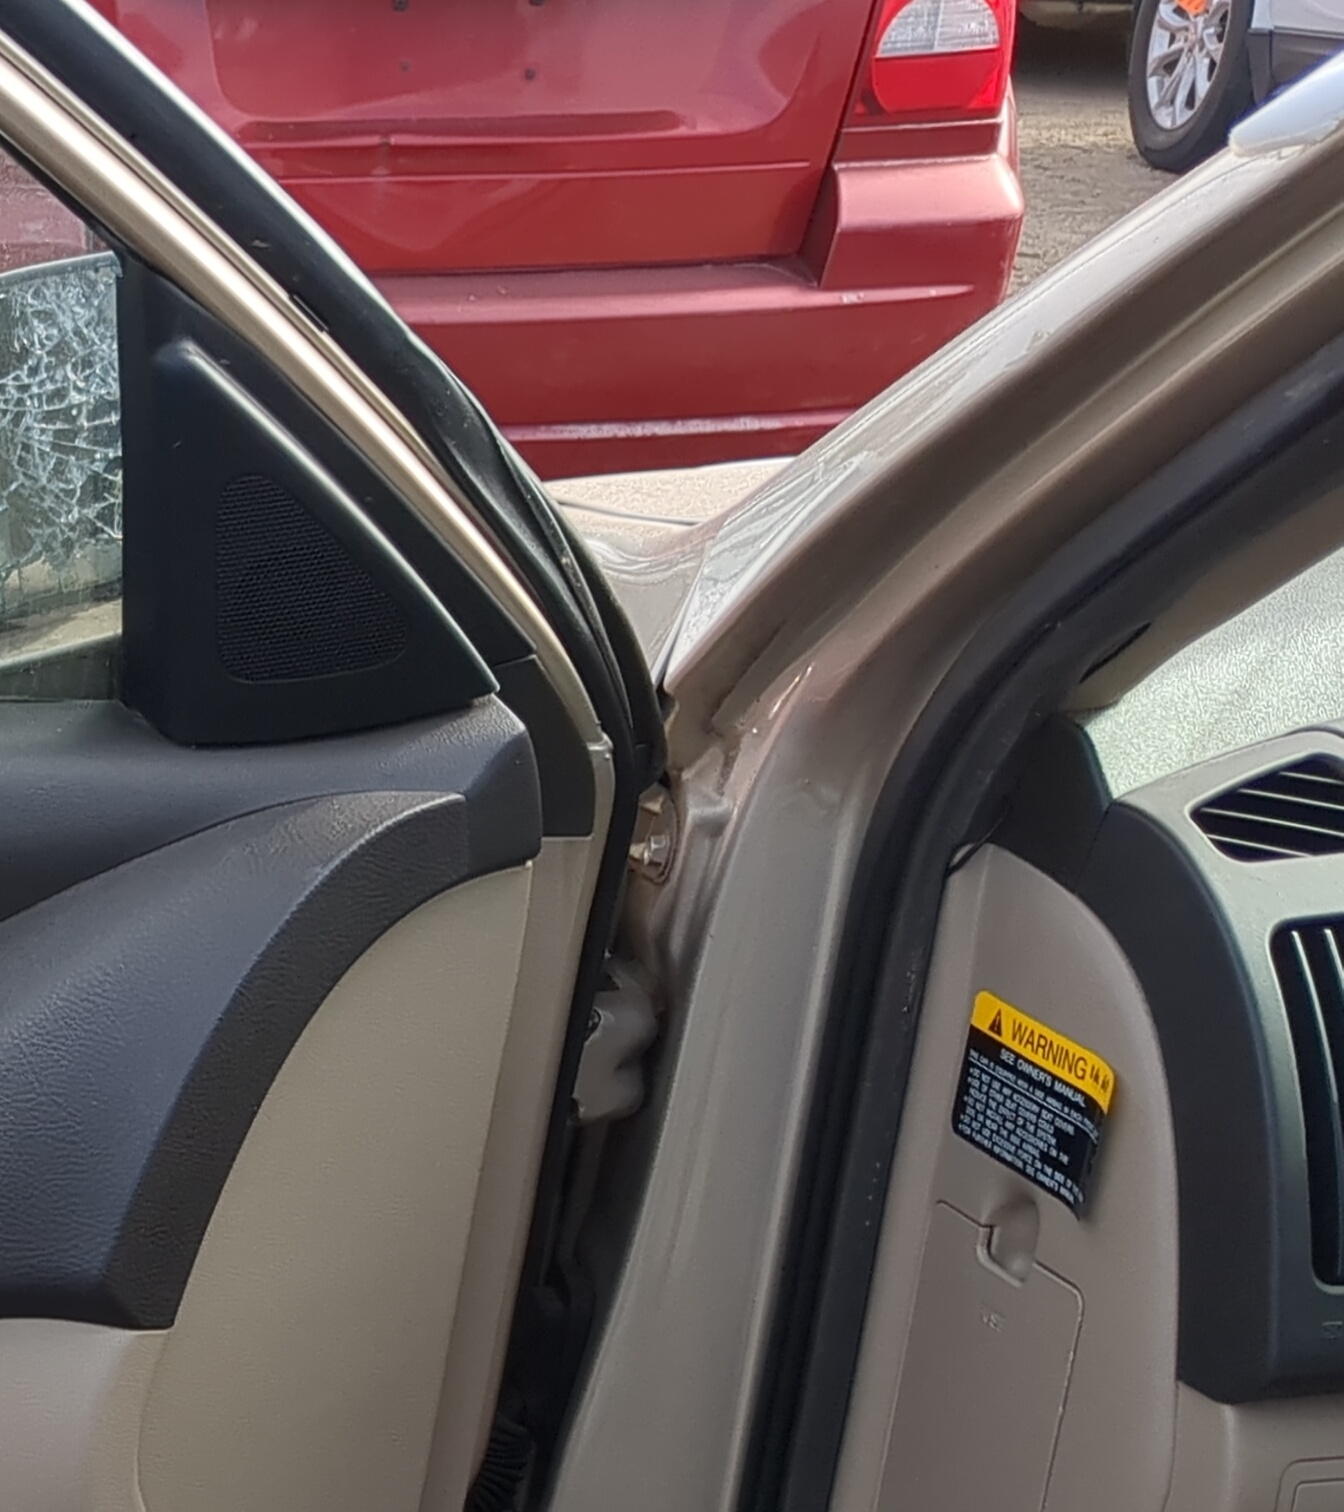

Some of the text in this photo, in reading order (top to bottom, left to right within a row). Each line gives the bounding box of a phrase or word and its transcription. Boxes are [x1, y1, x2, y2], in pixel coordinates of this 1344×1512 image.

[1000, 1048, 1086, 1108] SEE OWNER'S MANUAL
[1011, 1018, 1088, 1081] WARNING
